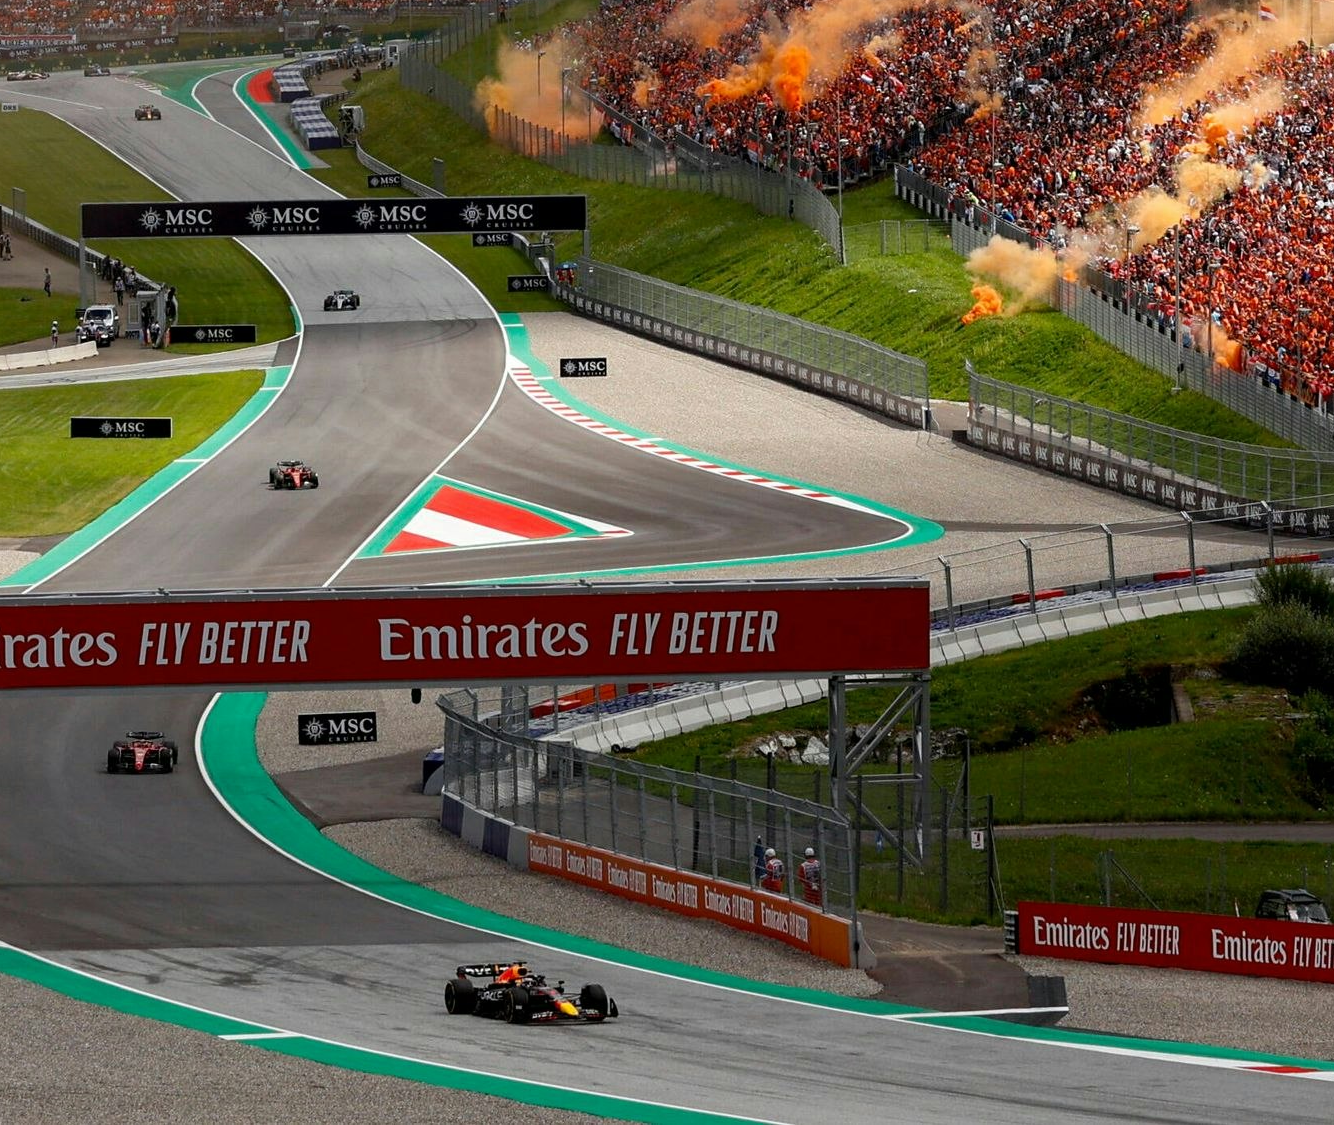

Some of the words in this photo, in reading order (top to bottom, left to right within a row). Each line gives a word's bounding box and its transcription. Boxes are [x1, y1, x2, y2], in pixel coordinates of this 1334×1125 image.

[380, 176, 400, 184] MSC
[165, 209, 212, 225] MSC
[273, 207, 319, 224] MSC
[379, 205, 427, 222] MSC
[487, 204, 533, 220] MSC
[487, 234, 508, 242] MSC
[523, 279, 547, 287] MSC
[208, 328, 233, 338] MSC
[578, 361, 605, 371] MSC
[115, 422, 145, 433] MSC
[139, 622, 191, 666] FLY
[199, 620, 310, 664] BETTER
[378, 615, 589, 661] Emirates
[609, 612, 661, 656] FLY
[669, 610, 778, 654] BETTER
[328, 718, 373, 735] MSC
[1033, 916, 1109, 951] Emirates
[1117, 922, 1136, 952] FLY
[1139, 924, 1179, 955] BETTER
[1211, 928, 1287, 966] Emirates
[1293, 936, 1312, 967] FLY
